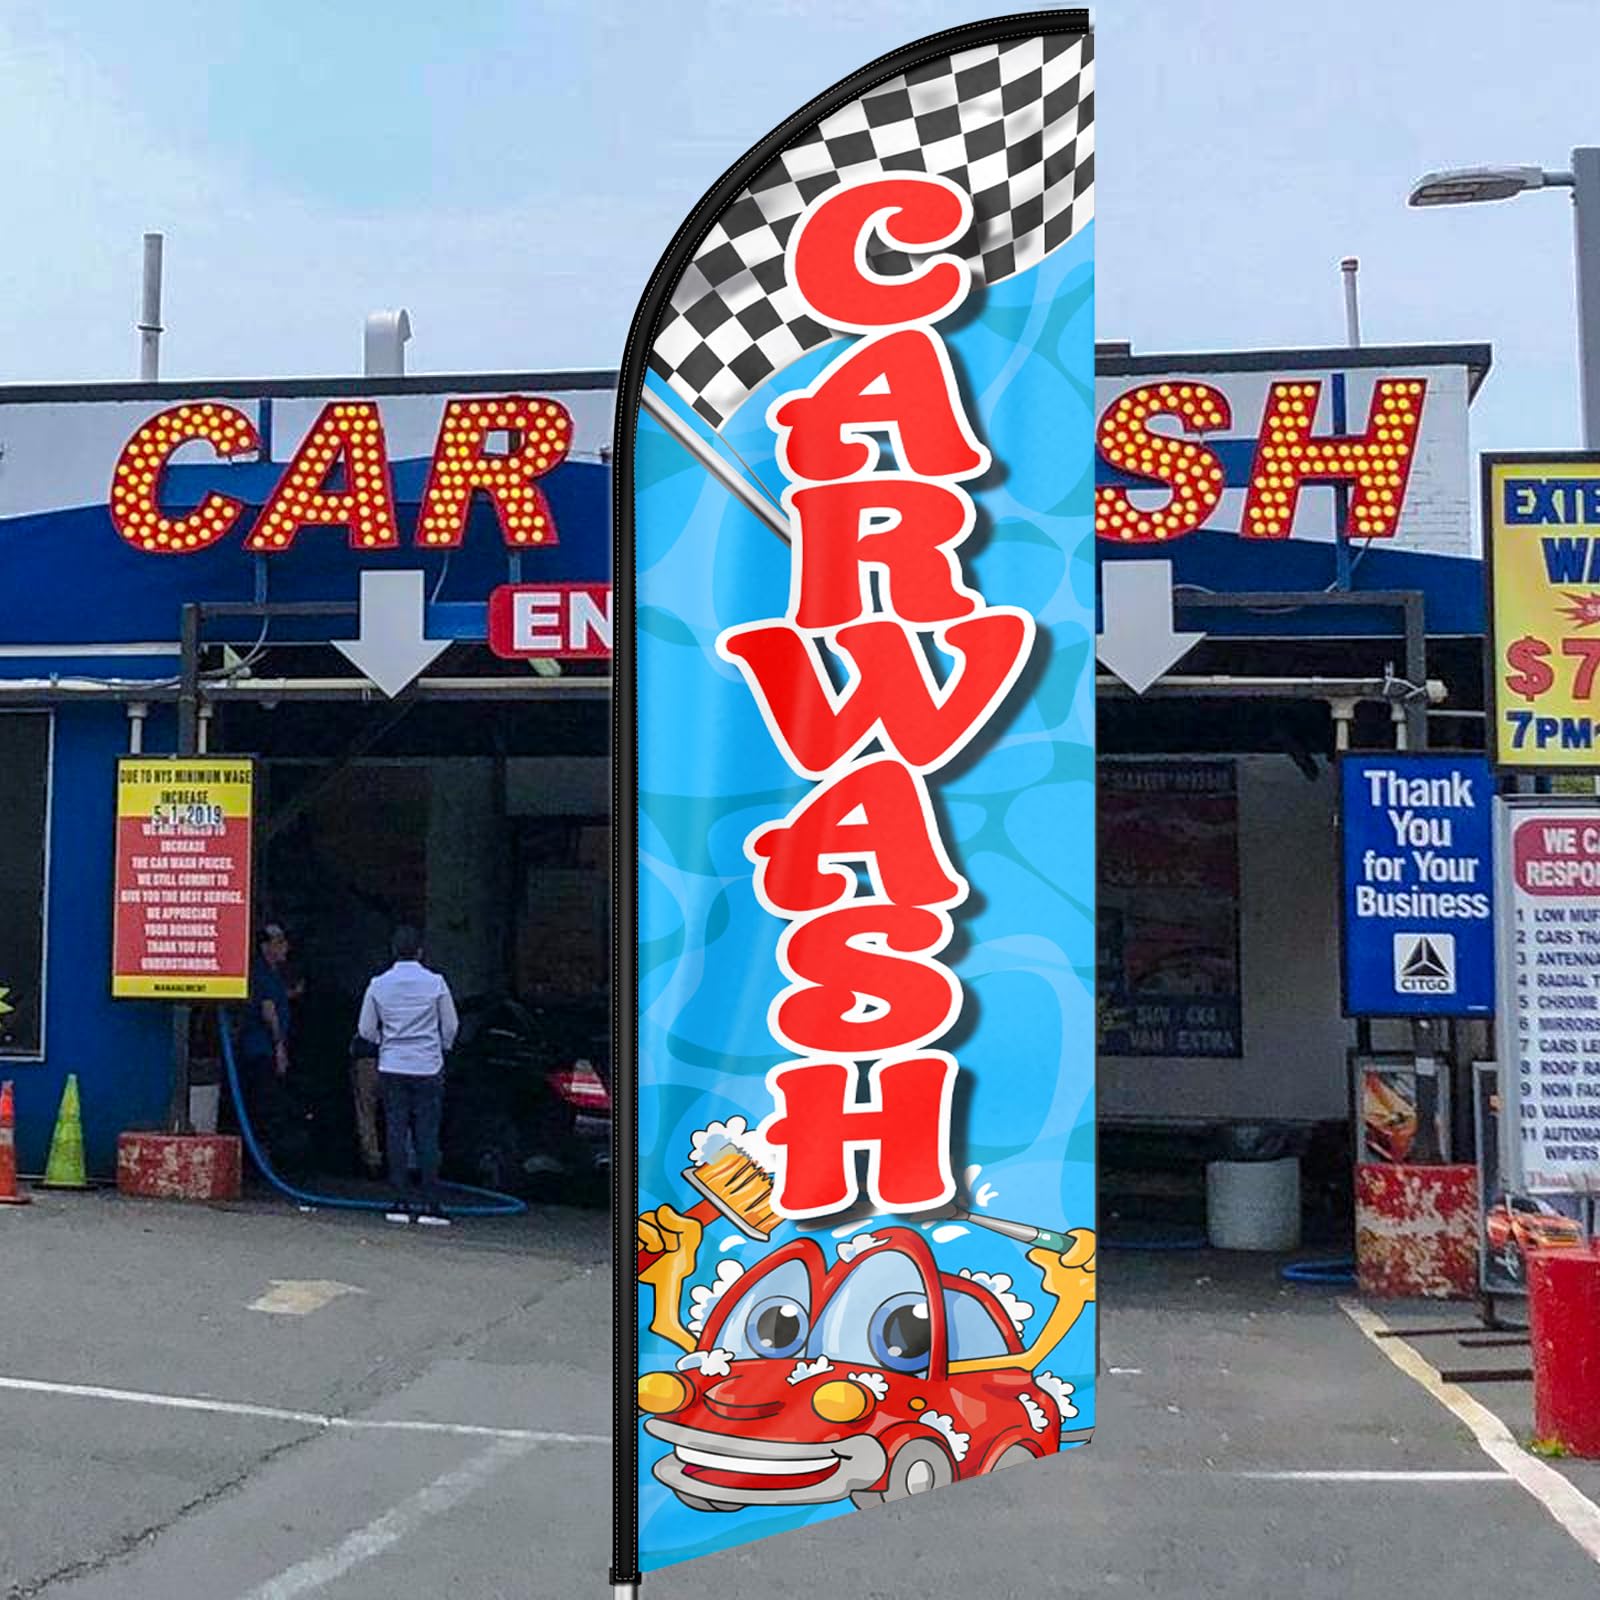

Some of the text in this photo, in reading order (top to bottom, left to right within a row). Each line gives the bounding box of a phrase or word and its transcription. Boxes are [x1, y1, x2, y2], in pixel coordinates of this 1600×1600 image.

[110, 395, 573, 553] CAR
[120, 769, 252, 784] DUE TO NYS MINIMUM WAGE
[1363, 770, 1475, 807] Thank
[161, 790, 208, 804] INCREASE
[1388, 810, 1452, 847] You
[1543, 827, 1577, 854] WE
[132, 857, 149, 870] THE
[150, 857, 168, 870] CAR
[169, 857, 197, 870] WASH
[1363, 850, 1479, 882] for Your
[137, 873, 228, 886] WE STILL COMMIT TO
[121, 890, 141, 903] GIVE
[142, 890, 160, 903] YOU
[161, 890, 178, 903] THE
[179, 890, 202, 903] BEST
[1356, 885, 1490, 918] Business
[146, 907, 217, 920] WE APPRECIATE
[1517, 909, 1523, 921] 1
[1534, 909, 1564, 921] LOW
[144, 923, 168, 937] YOUR
[1517, 930, 1526, 944] 2
[1535, 930, 1573, 944] CARS
[147, 940, 216, 953] THANK YOU FOR
[1517, 952, 1526, 966] 3
[1400, 978, 1450, 991] CITGO
[1518, 974, 1527, 987] 4
[1537, 974, 1588, 987] RADIAL
[1519, 995, 1599, 1009] 5 CHROME
[1520, 1017, 1529, 1031] 6
[1520, 1038, 1529, 1053] 7
[1540, 1038, 1577, 1053] CARS
[1520, 1060, 1531, 1075] 8
[1541, 1060, 1577, 1075] ROOF
[1521, 1082, 1531, 1096] 9
[1541, 1082, 1572, 1096] NON
[1520, 1104, 1537, 1118] 10
[1521, 1126, 1537, 1140] 11
[1544, 1145, 1599, 1160] WIPERS
